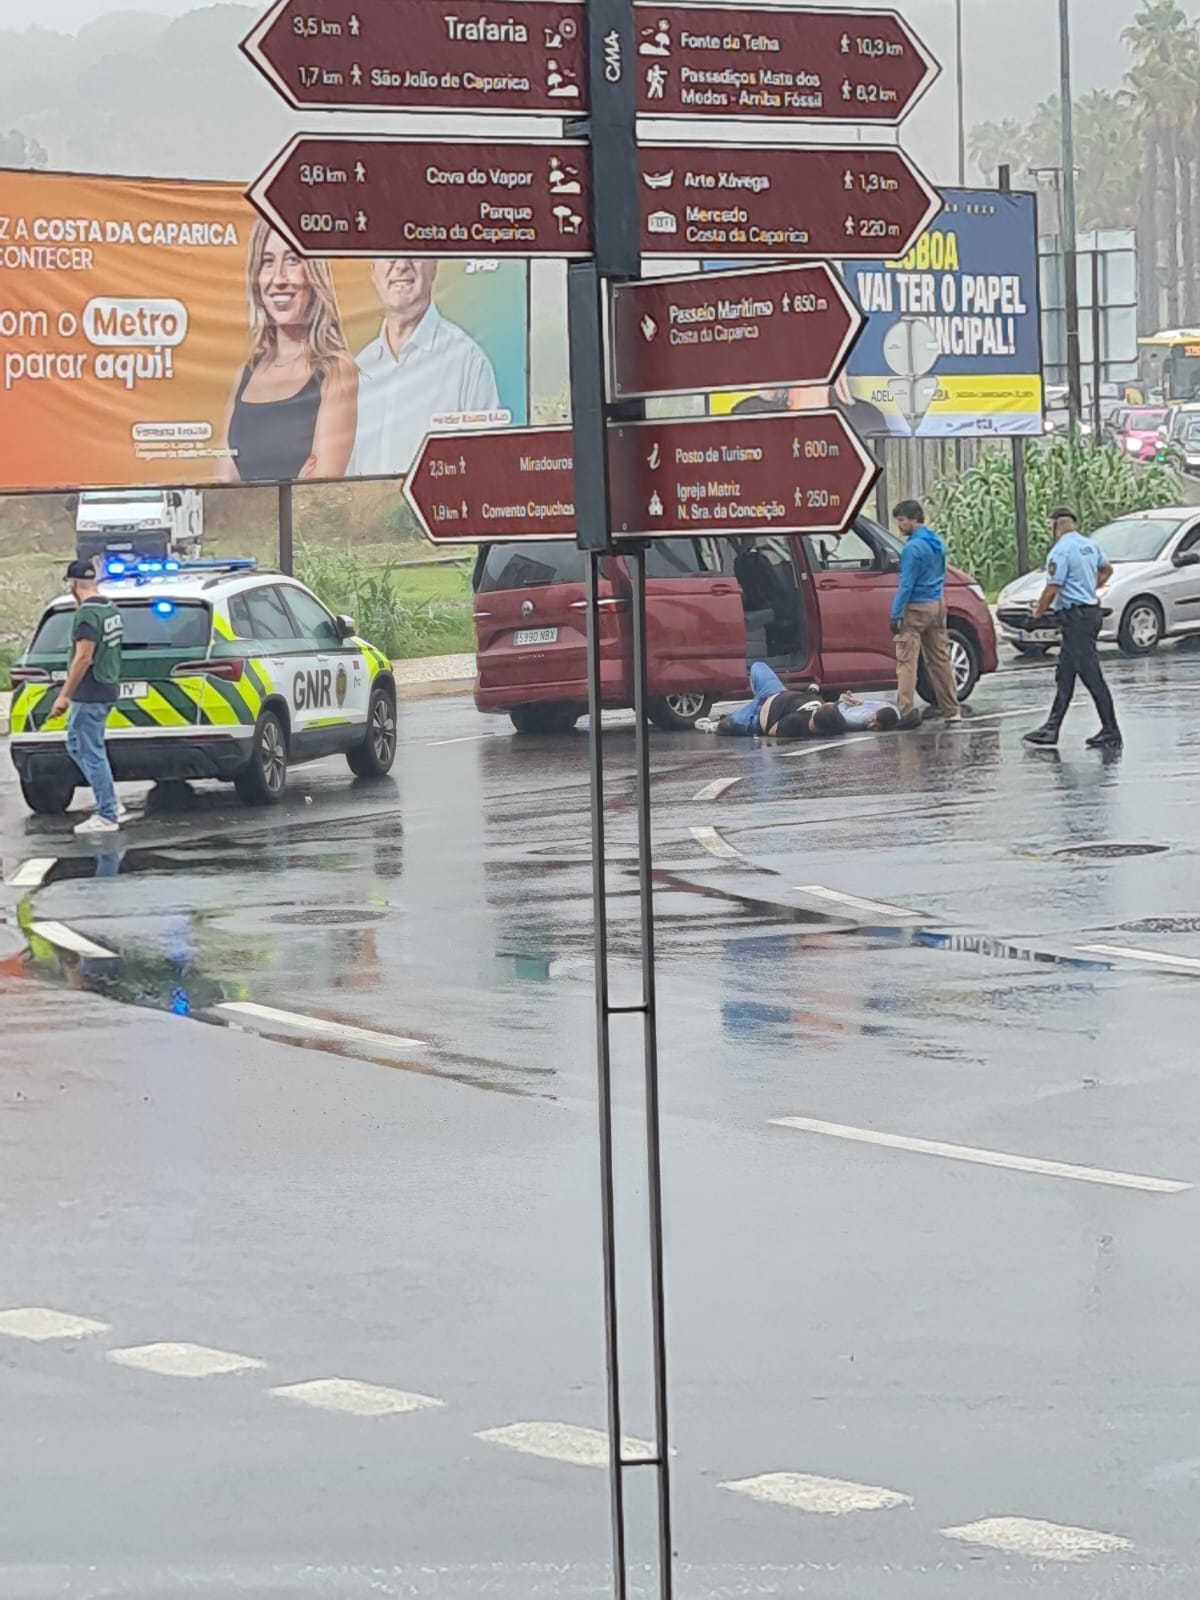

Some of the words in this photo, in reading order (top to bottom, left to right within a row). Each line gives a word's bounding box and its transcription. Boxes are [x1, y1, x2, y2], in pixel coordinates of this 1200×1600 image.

[321, 19, 342, 36] km
[444, 16, 528, 42] Trafaria
[681, 32, 720, 49] Fonte
[743, 34, 780, 51] Telha
[856, 39, 884, 57] 10,3
[885, 41, 903, 56] km
[604, 30, 620, 81] CMA
[299, 67, 319, 87] 1,7
[323, 69, 343, 85] km
[371, 69, 400, 86] São
[404, 71, 438, 87] João
[441, 73, 460, 88] de
[463, 72, 529, 93] Caparica
[681, 67, 757, 88] Passadiços
[760, 70, 793, 85] Mata
[796, 71, 820, 87] dos
[739, 90, 782, 107] Arriba
[880, 86, 897, 101] km
[326, 166, 347, 183] km
[426, 167, 464, 184] Cova
[467, 168, 487, 184] do
[489, 168, 533, 189] Vapor
[880, 175, 898, 190] km
[480, 202, 533, 223] Parque
[686, 205, 747, 222] Mercado
[14, 217, 29, 240] A
[33, 217, 102, 242] COSTA
[105, 221, 135, 244] DA
[137, 223, 238, 246] CAPARICA
[335, 217, 348, 231] m
[404, 223, 447, 239] Costa
[450, 224, 468, 240] da
[471, 223, 535, 243] Caparica
[888, 223, 900, 235] m
[686, 227, 726, 242] Costa
[729, 227, 747, 242] da
[749, 227, 809, 246] Caparica
[0, 247, 93, 270] ONTECER
[857, 272, 892, 312] VAI
[895, 273, 936, 313] TER
[940, 274, 956, 314] O
[961, 275, 1027, 314] PAPEL
[669, 303, 715, 323] Passeio
[717, 297, 773, 319] Marítimo
[817, 299, 828, 310] m
[58, 312, 77, 337] o
[93, 307, 178, 337] Metro
[670, 329, 698, 344] Costa
[701, 327, 712, 342] da
[714, 323, 758, 344] Caparica
[5, 351, 87, 390] parar
[95, 345, 174, 390] aqui!
[675, 448, 704, 464] Posto
[706, 446, 719, 463] de
[721, 444, 762, 462] Turismo
[804, 440, 826, 458] 600
[828, 444, 839, 456] m
[429, 460, 444, 479] 2,3
[445, 462, 457, 475] km
[520, 456, 573, 471] Miradouros
[677, 483, 706, 500] Igreja
[708, 481, 741, 498] Matriz
[806, 490, 828, 508] 250
[829, 494, 840, 506] m
[432, 505, 445, 522] 1,9
[446, 506, 459, 520] km
[482, 503, 526, 519] Convento
[527, 501, 575, 520] Capuchos
[677, 505, 690, 520] N.
[691, 504, 712, 519] Sra.
[713, 503, 727, 518] da
[729, 501, 785, 520] Conceição
[293, 669, 331, 710] GNR
